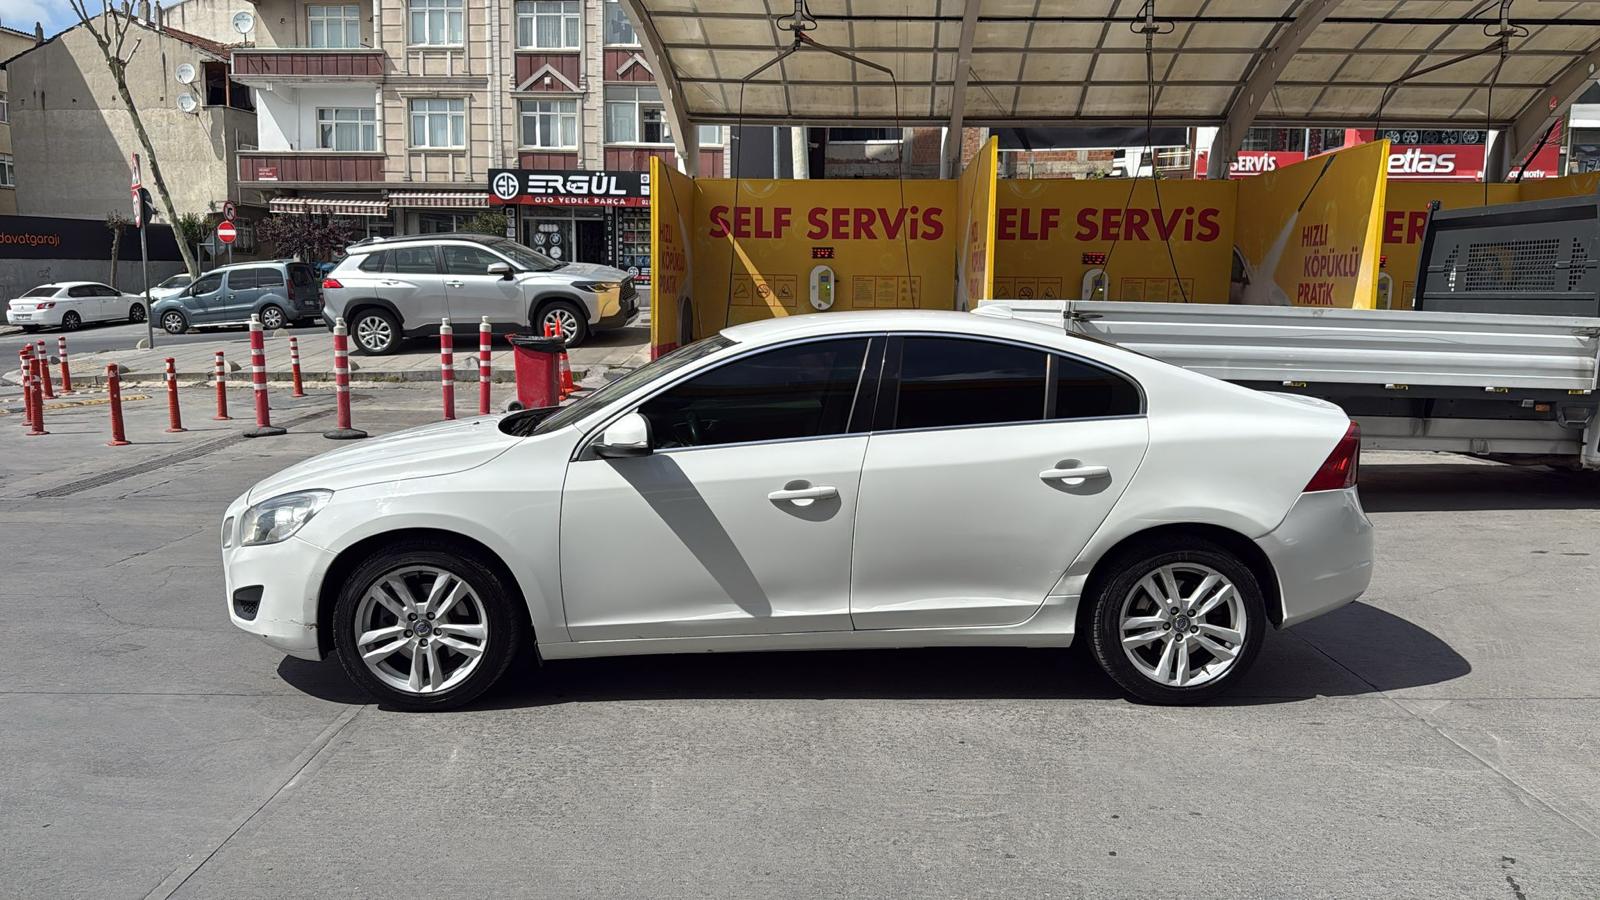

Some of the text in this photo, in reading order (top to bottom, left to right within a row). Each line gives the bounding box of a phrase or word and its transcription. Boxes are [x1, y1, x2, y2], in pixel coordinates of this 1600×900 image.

[1387, 148, 1456, 173] etlas
[527, 172, 627, 195] ERGÜL
[534, 196, 626, 207] OTO YEDEK PARÇA
[709, 205, 792, 239] SELF
[997, 208, 1060, 241] ELF
[1301, 224, 1328, 247] HIZLI
[1383, 211, 1428, 244] ER
[1303, 246, 1359, 277] KÖPÜKLÜ
